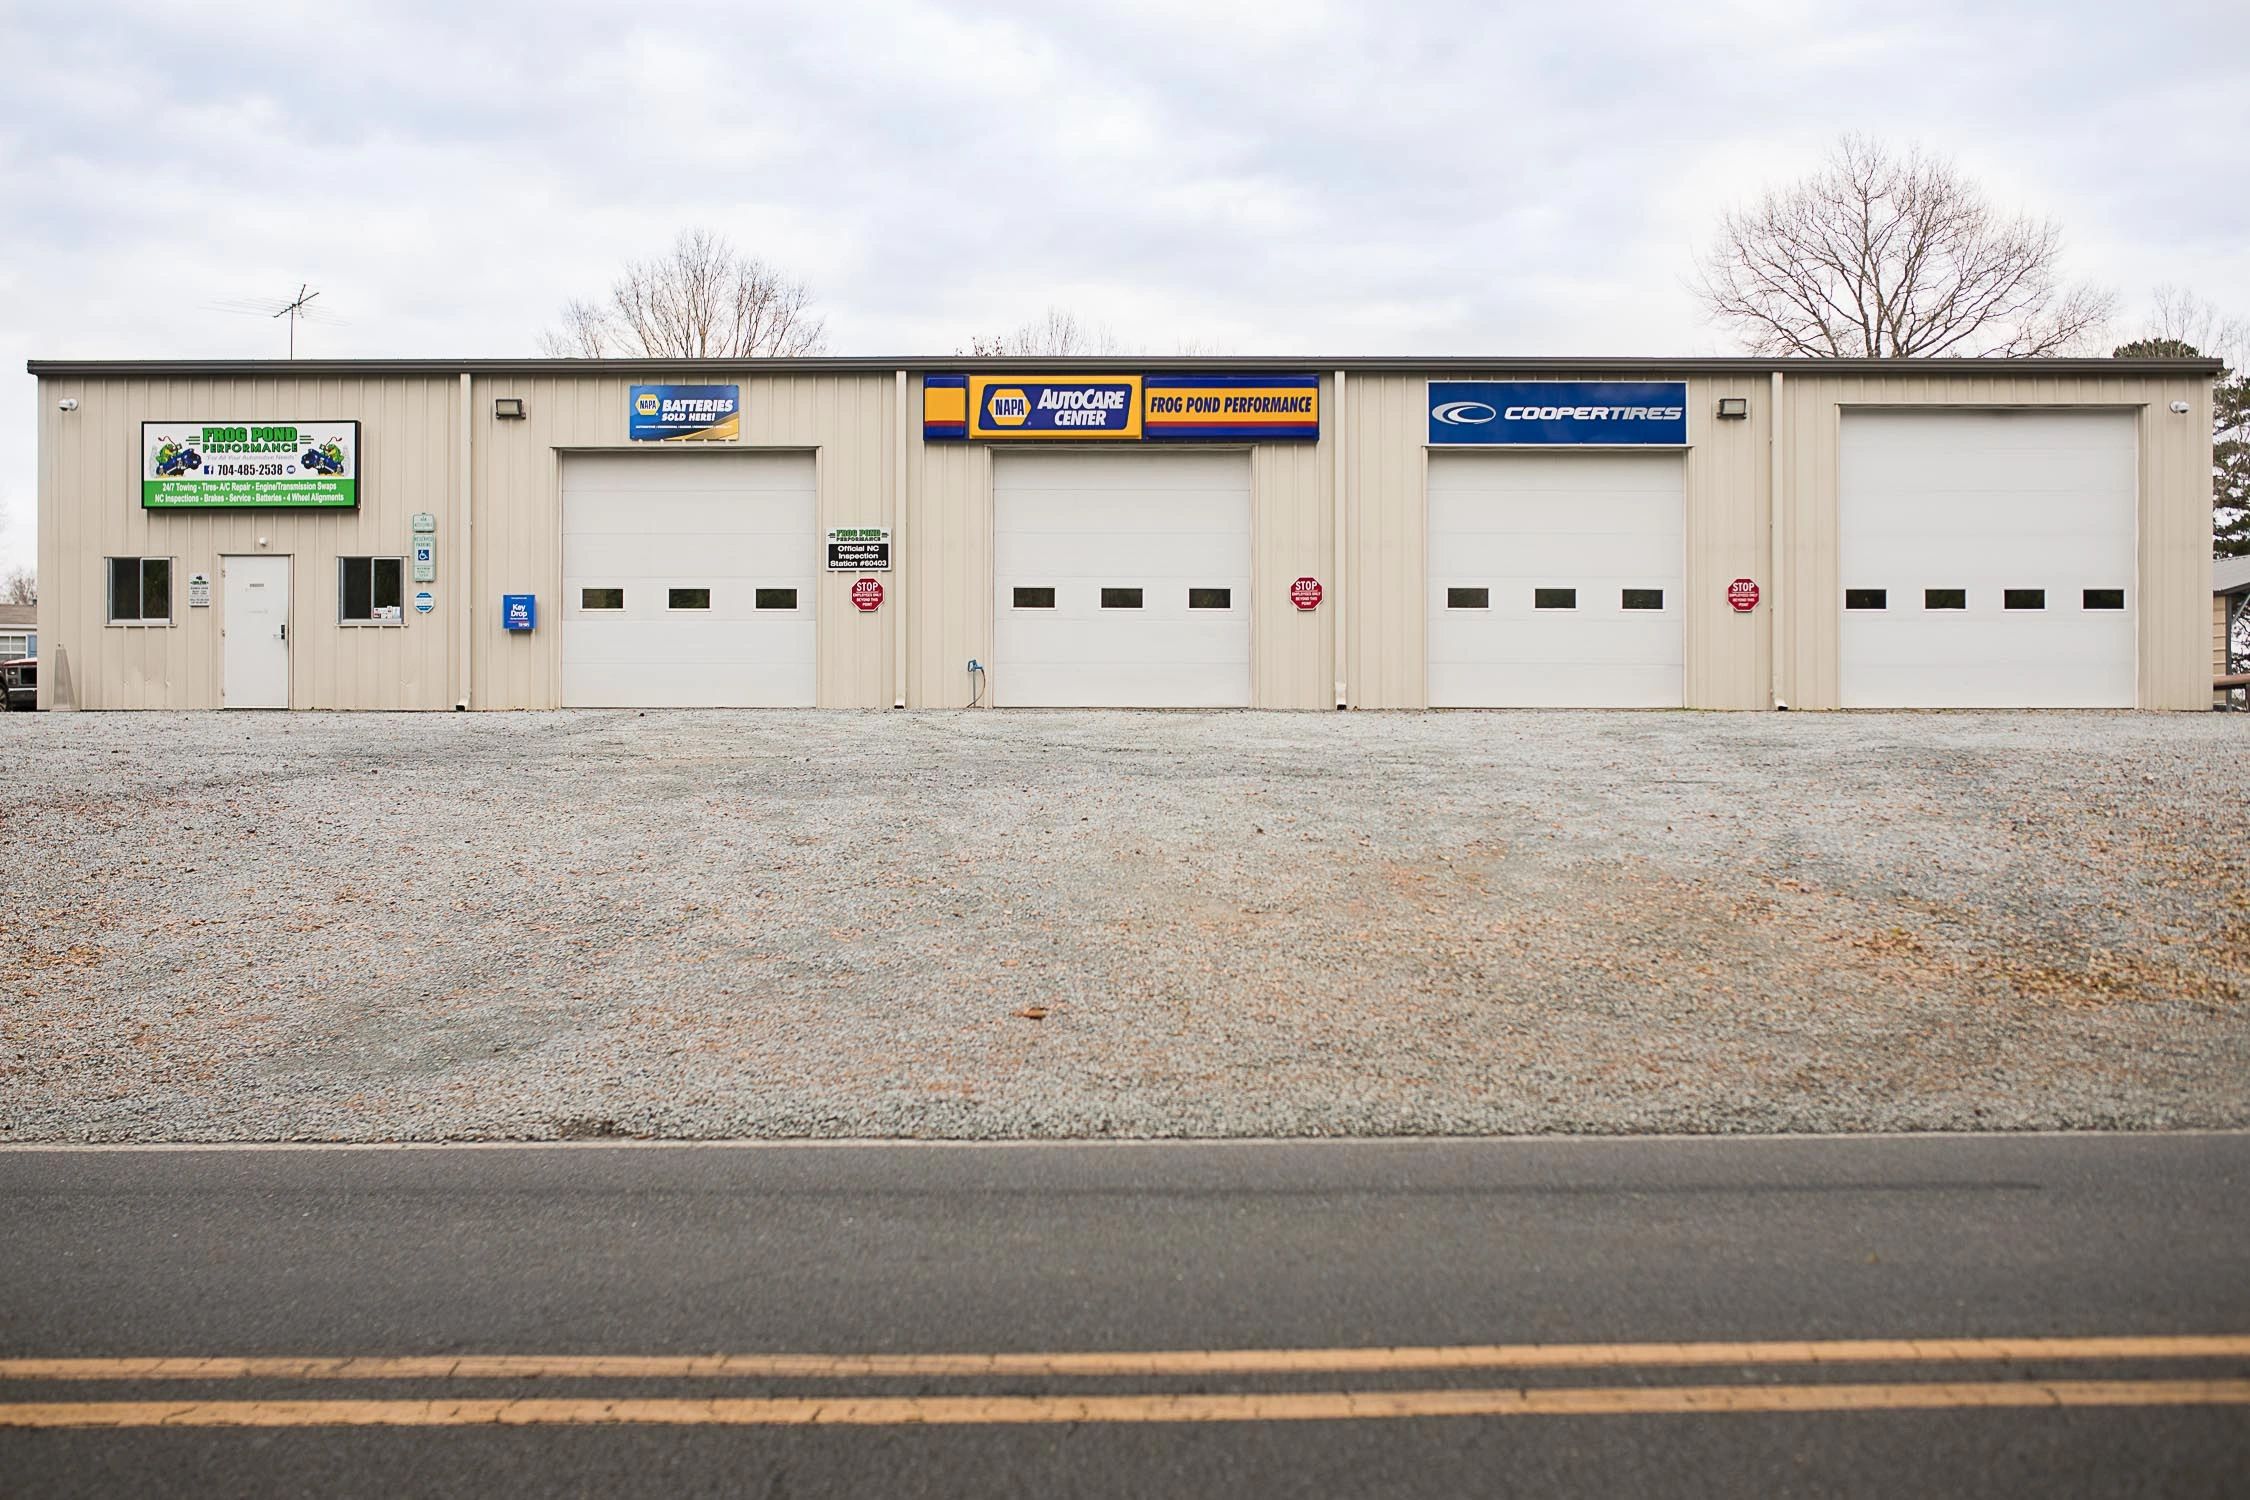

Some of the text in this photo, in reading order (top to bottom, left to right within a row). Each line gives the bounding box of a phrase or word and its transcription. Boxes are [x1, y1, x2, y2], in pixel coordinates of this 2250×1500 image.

[640, 400, 656, 409] NAPA
[662, 400, 734, 412] BATTERIES
[995, 399, 1024, 416] NAPA
[1150, 397, 1312, 412] FROG POND PERFORMANCE
[662, 413, 715, 421] SOLD HERE!
[1054, 410, 1107, 425] CENTER
[202, 427, 297, 442] FROG POND
[202, 443, 297, 453] PERFORMANCE
[218, 464, 283, 475] 704-485-2538
[163, 483, 175, 491] 24/7
[176, 483, 197, 493] Towing
[232, 483, 251, 492] Repair
[256, 482, 316, 492] Engine/Transmission
[318, 482, 336, 492] Swaps
[155, 493, 344, 504] NC Inspections Brakes Service Batteries 4 Wheel Alignments
[857, 582, 878, 592] STOP
[1296, 581, 1317, 590] STOP
[1733, 583, 1754, 591] STOP
